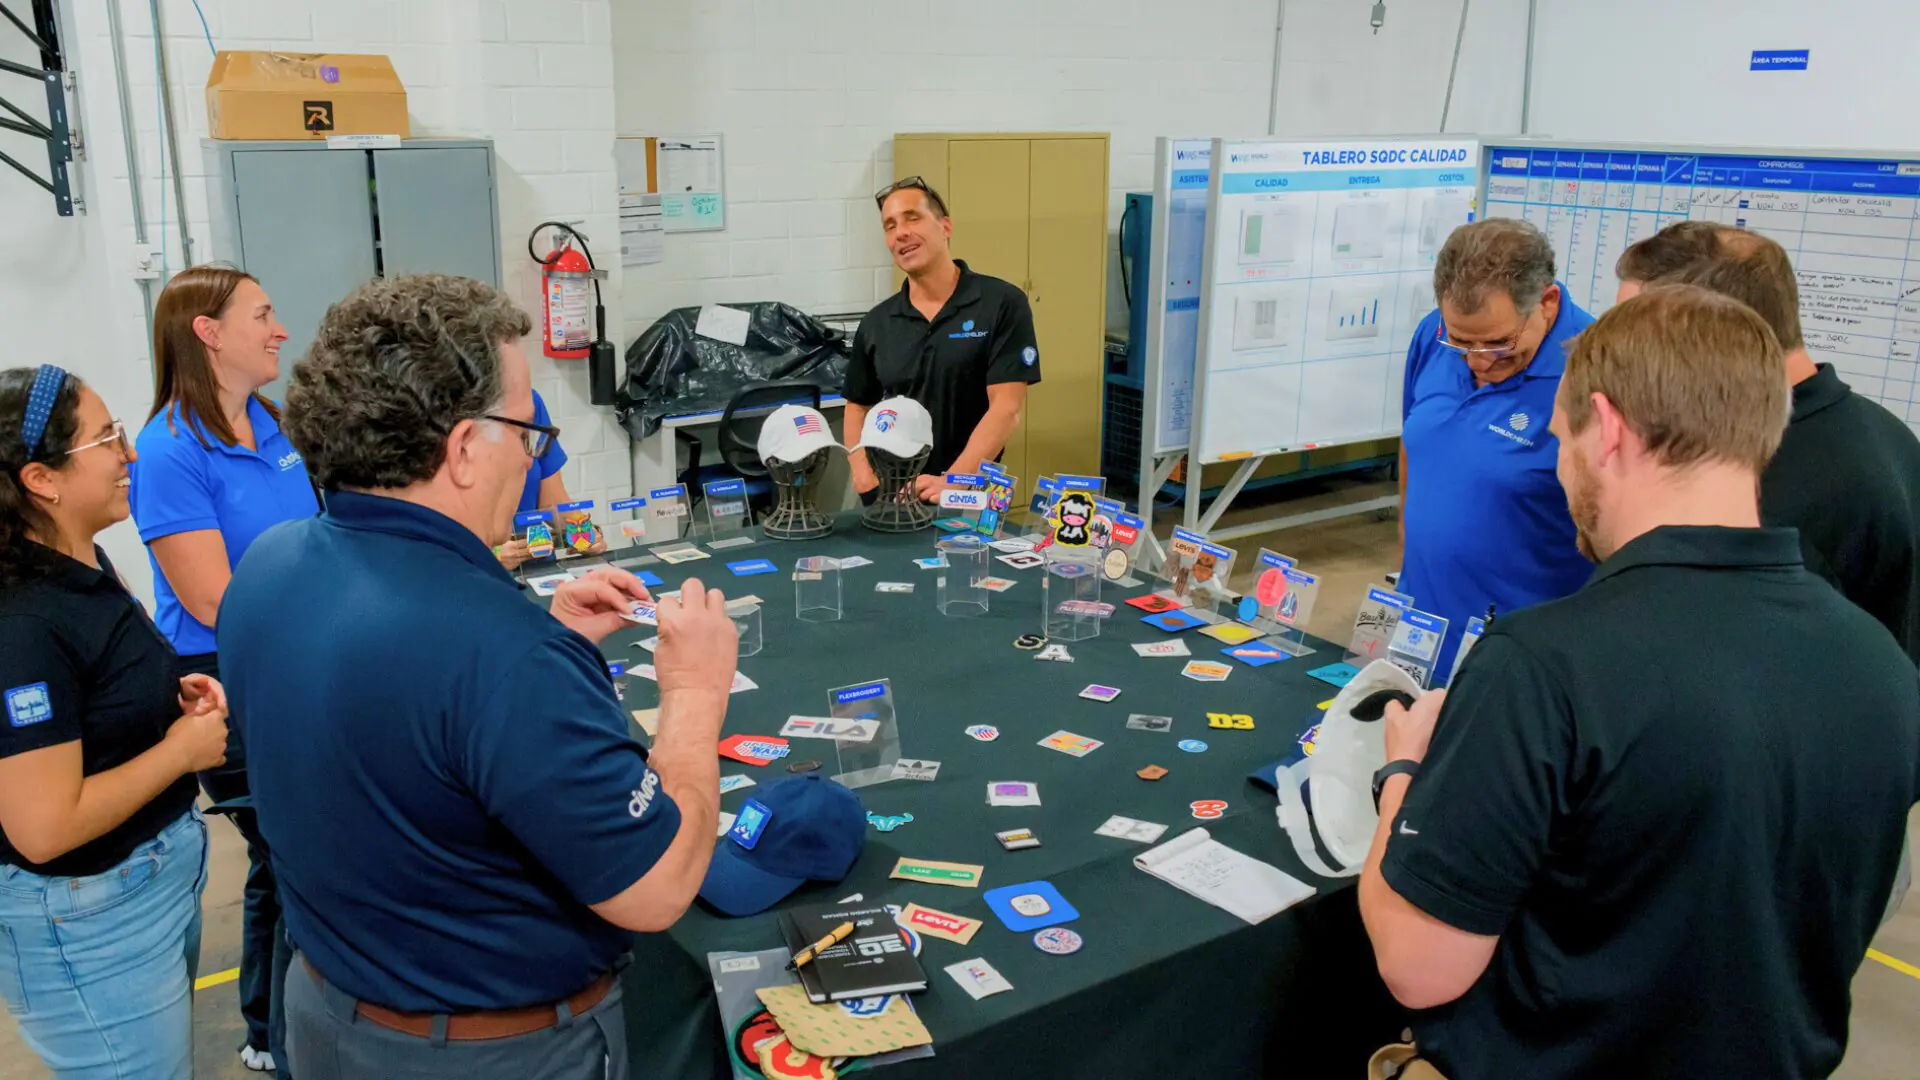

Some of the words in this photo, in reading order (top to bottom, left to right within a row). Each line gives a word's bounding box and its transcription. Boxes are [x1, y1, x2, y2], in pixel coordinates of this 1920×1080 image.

[1303, 150, 1367, 165] TABLERO
[1370, 149, 1407, 164] SQDC
[1410, 148, 1467, 163] CALIDAD
[1254, 178, 1289, 188] CALIDAD
[1348, 175, 1381, 185] ENTREGA
[1438, 173, 1465, 182] COSTOS
[838, 687, 880, 701] FLEXBROIDERY
[787, 720, 867, 738] FILA
